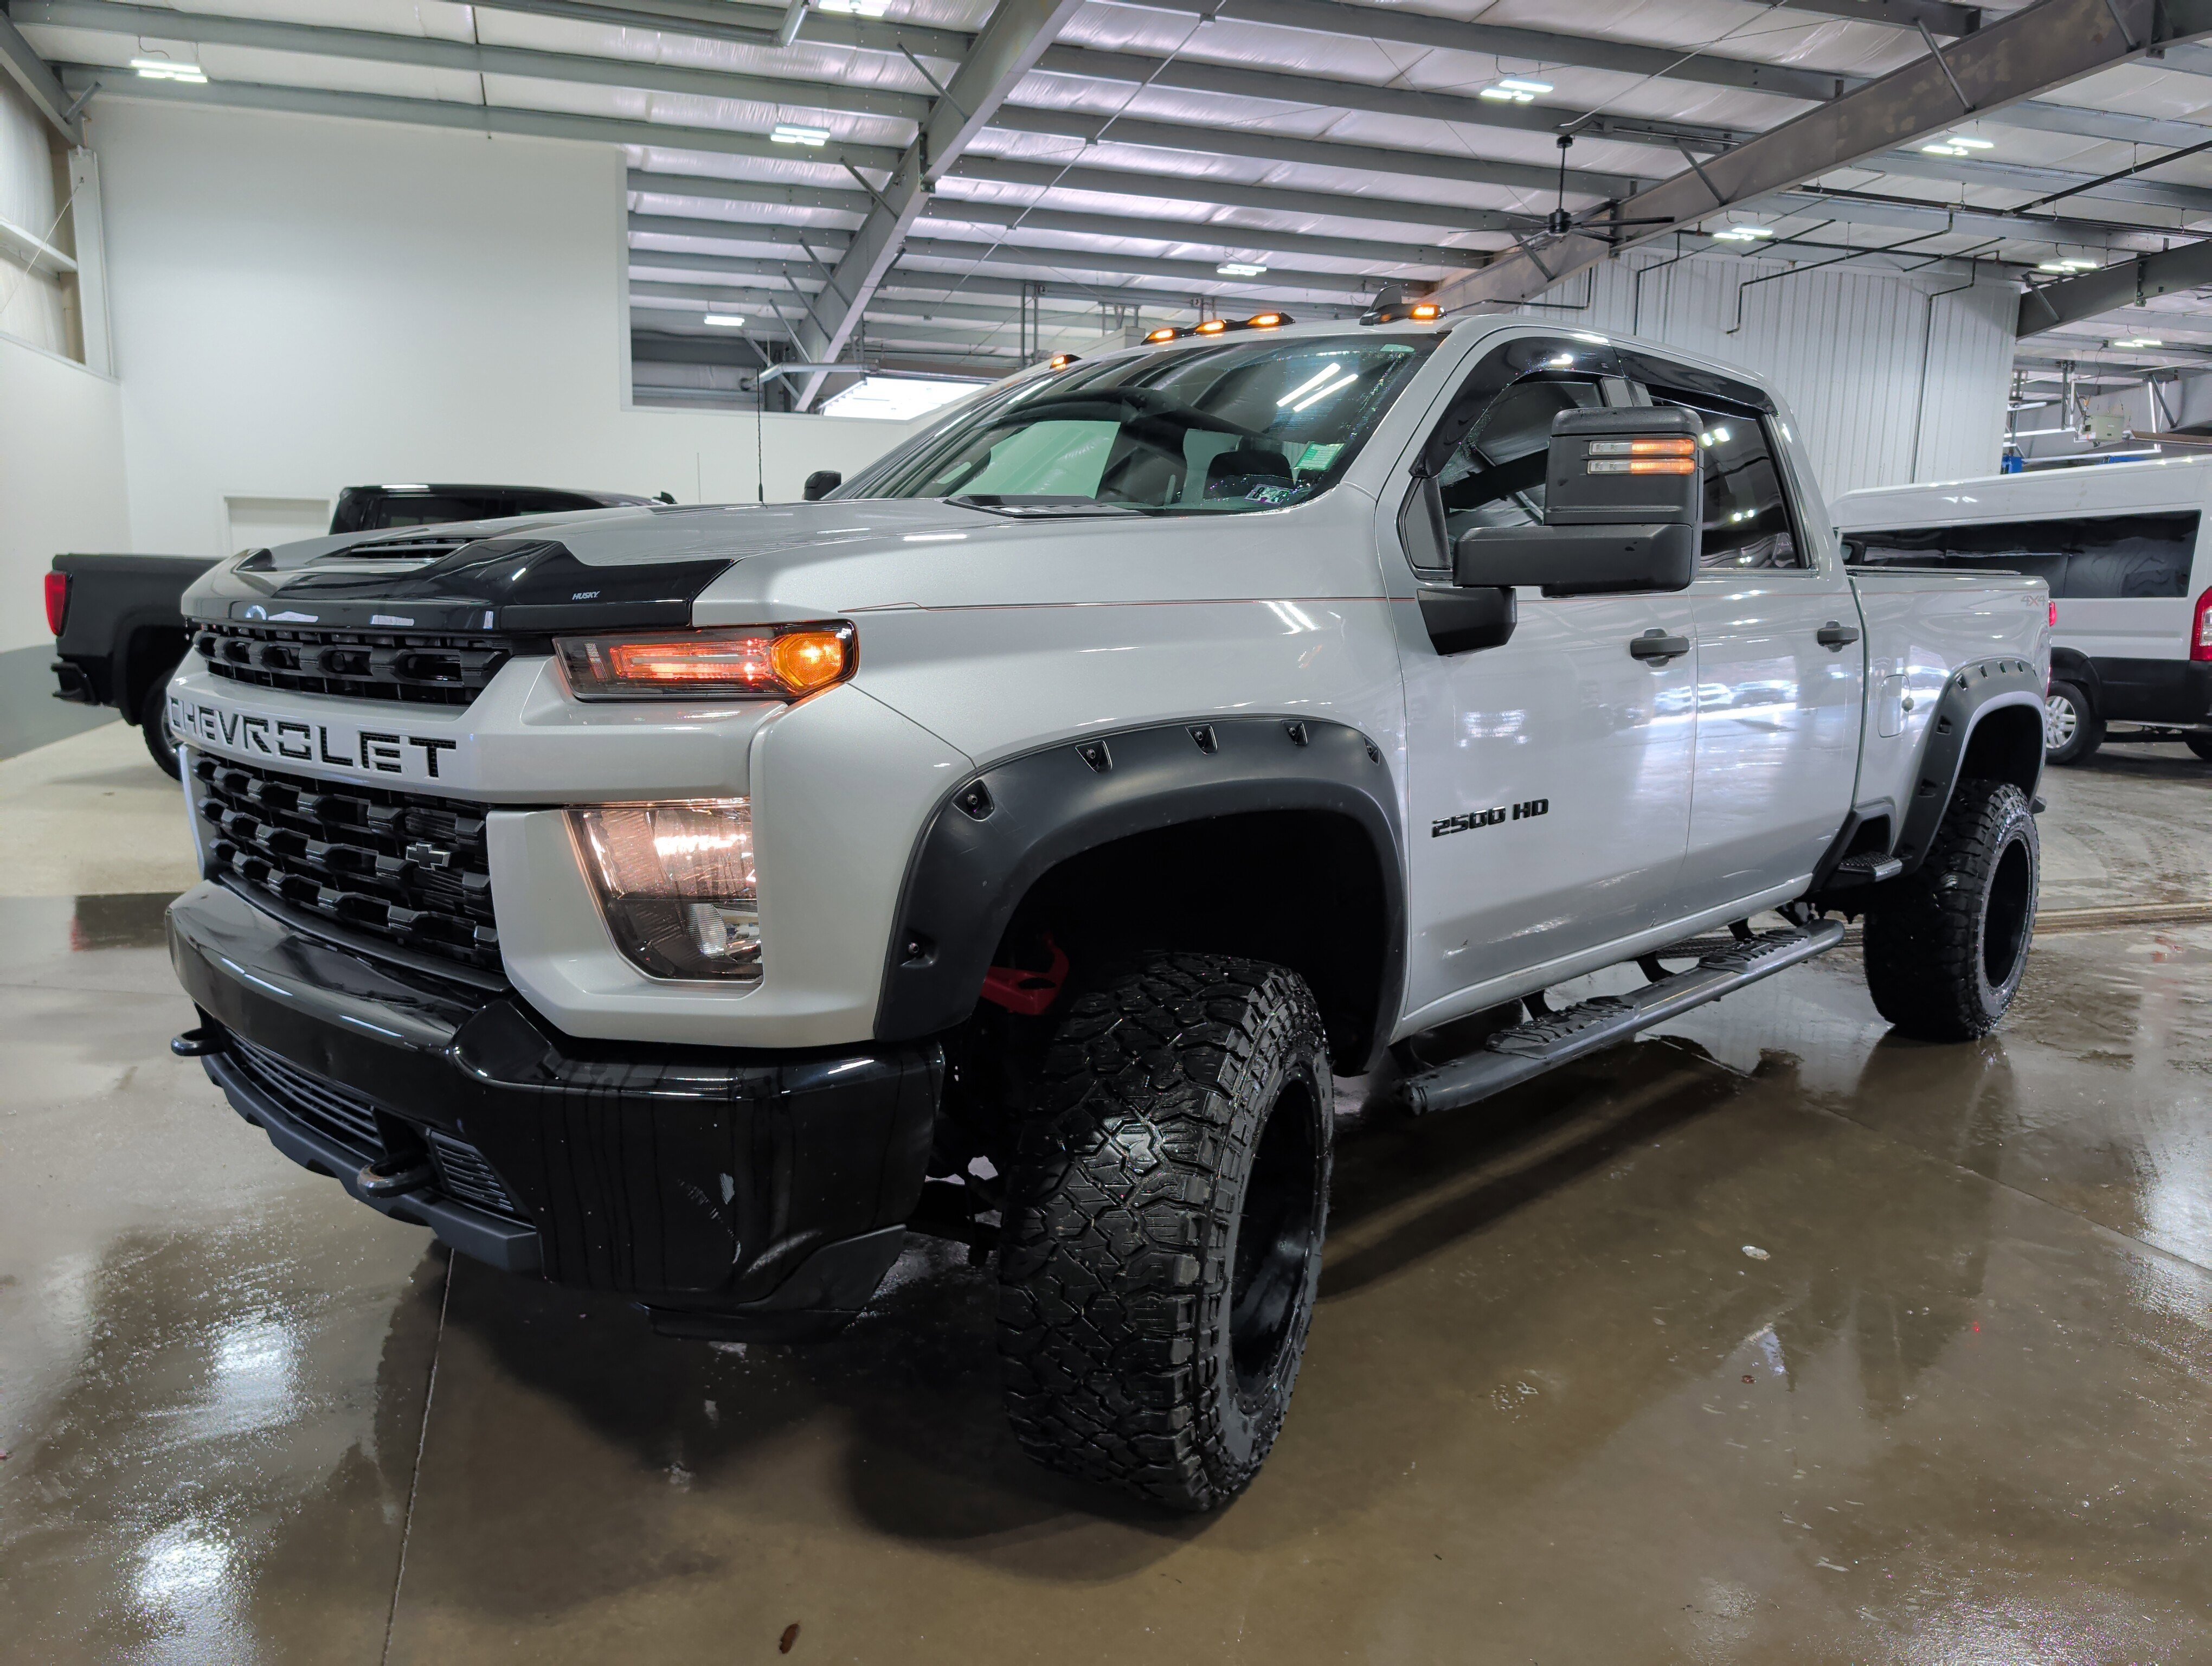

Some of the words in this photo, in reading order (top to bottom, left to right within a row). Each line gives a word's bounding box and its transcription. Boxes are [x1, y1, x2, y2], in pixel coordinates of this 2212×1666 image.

[572, 591, 600, 600] HUSKY
[167, 697, 457, 779] CHEVROLET
[1431, 806, 1507, 838] 2500
[1512, 798, 1549, 820] HD
